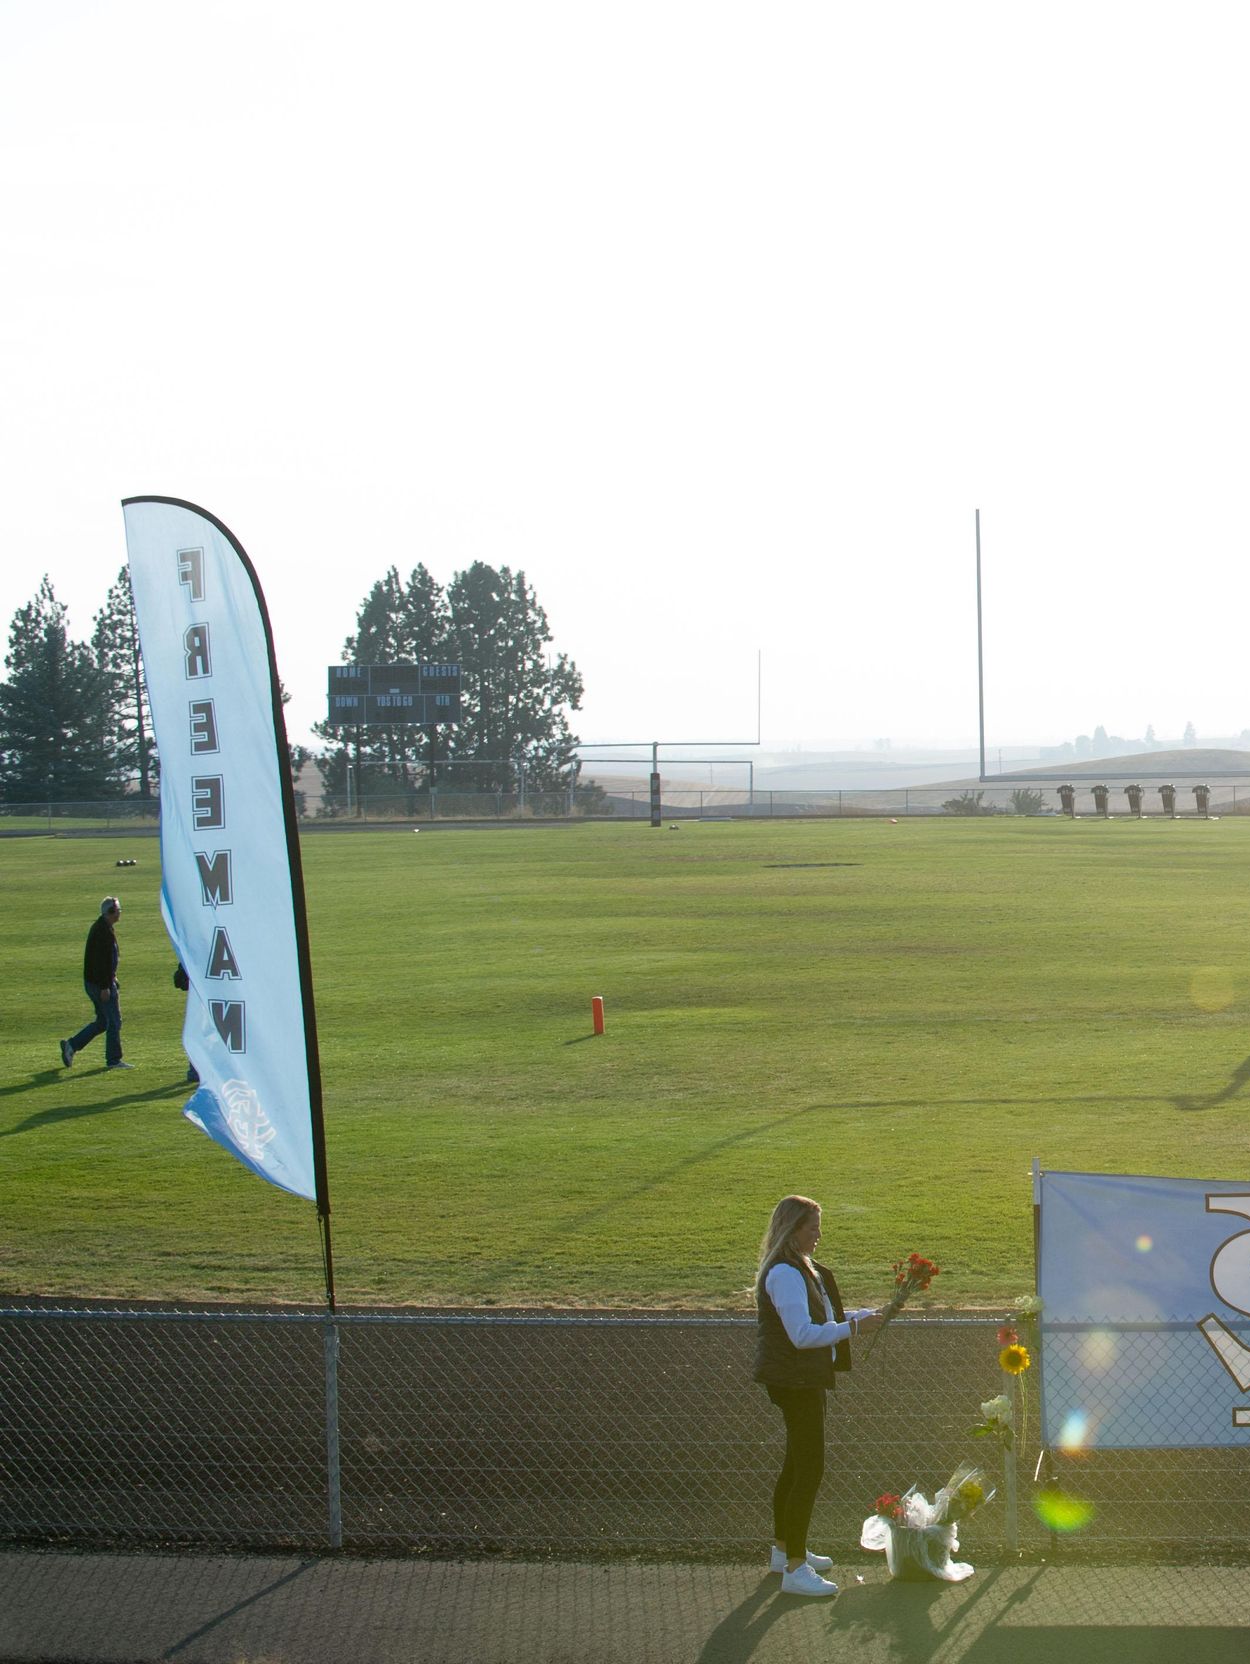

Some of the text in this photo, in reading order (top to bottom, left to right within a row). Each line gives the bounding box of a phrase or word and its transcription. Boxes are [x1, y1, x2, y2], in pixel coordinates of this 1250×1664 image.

[336, 667, 361, 678] HOME
[422, 666, 458, 677] GUESTS
[335, 696, 358, 707] DOWN
